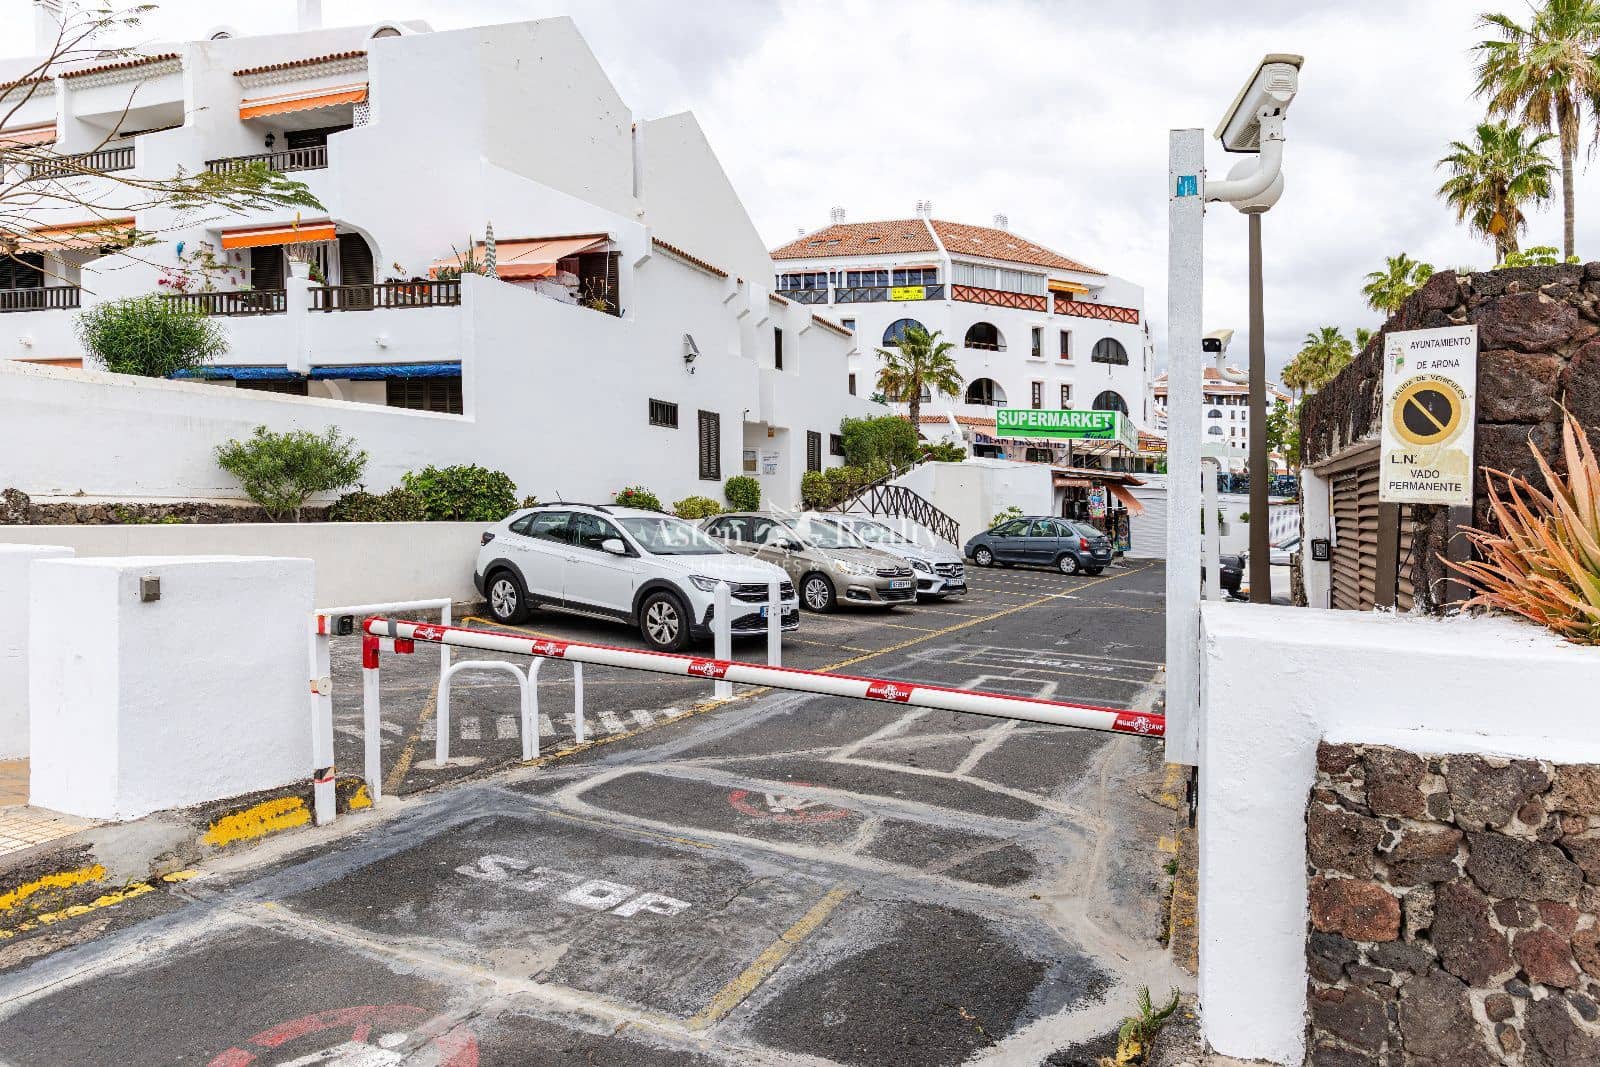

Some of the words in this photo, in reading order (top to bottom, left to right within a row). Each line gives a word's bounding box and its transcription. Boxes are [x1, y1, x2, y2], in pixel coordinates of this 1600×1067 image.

[1410, 337, 1471, 349] AYUNTAMIENTO
[1416, 361, 1427, 370] DE
[1431, 359, 1460, 369] ARONA
[1392, 380, 1412, 401] SALIDA
[998, 410, 1113, 428] SUPERMARKET
[1410, 470, 1440, 479] VADO
[1389, 481, 1462, 492] PERMANENTE
[454, 854, 693, 917] STOP
